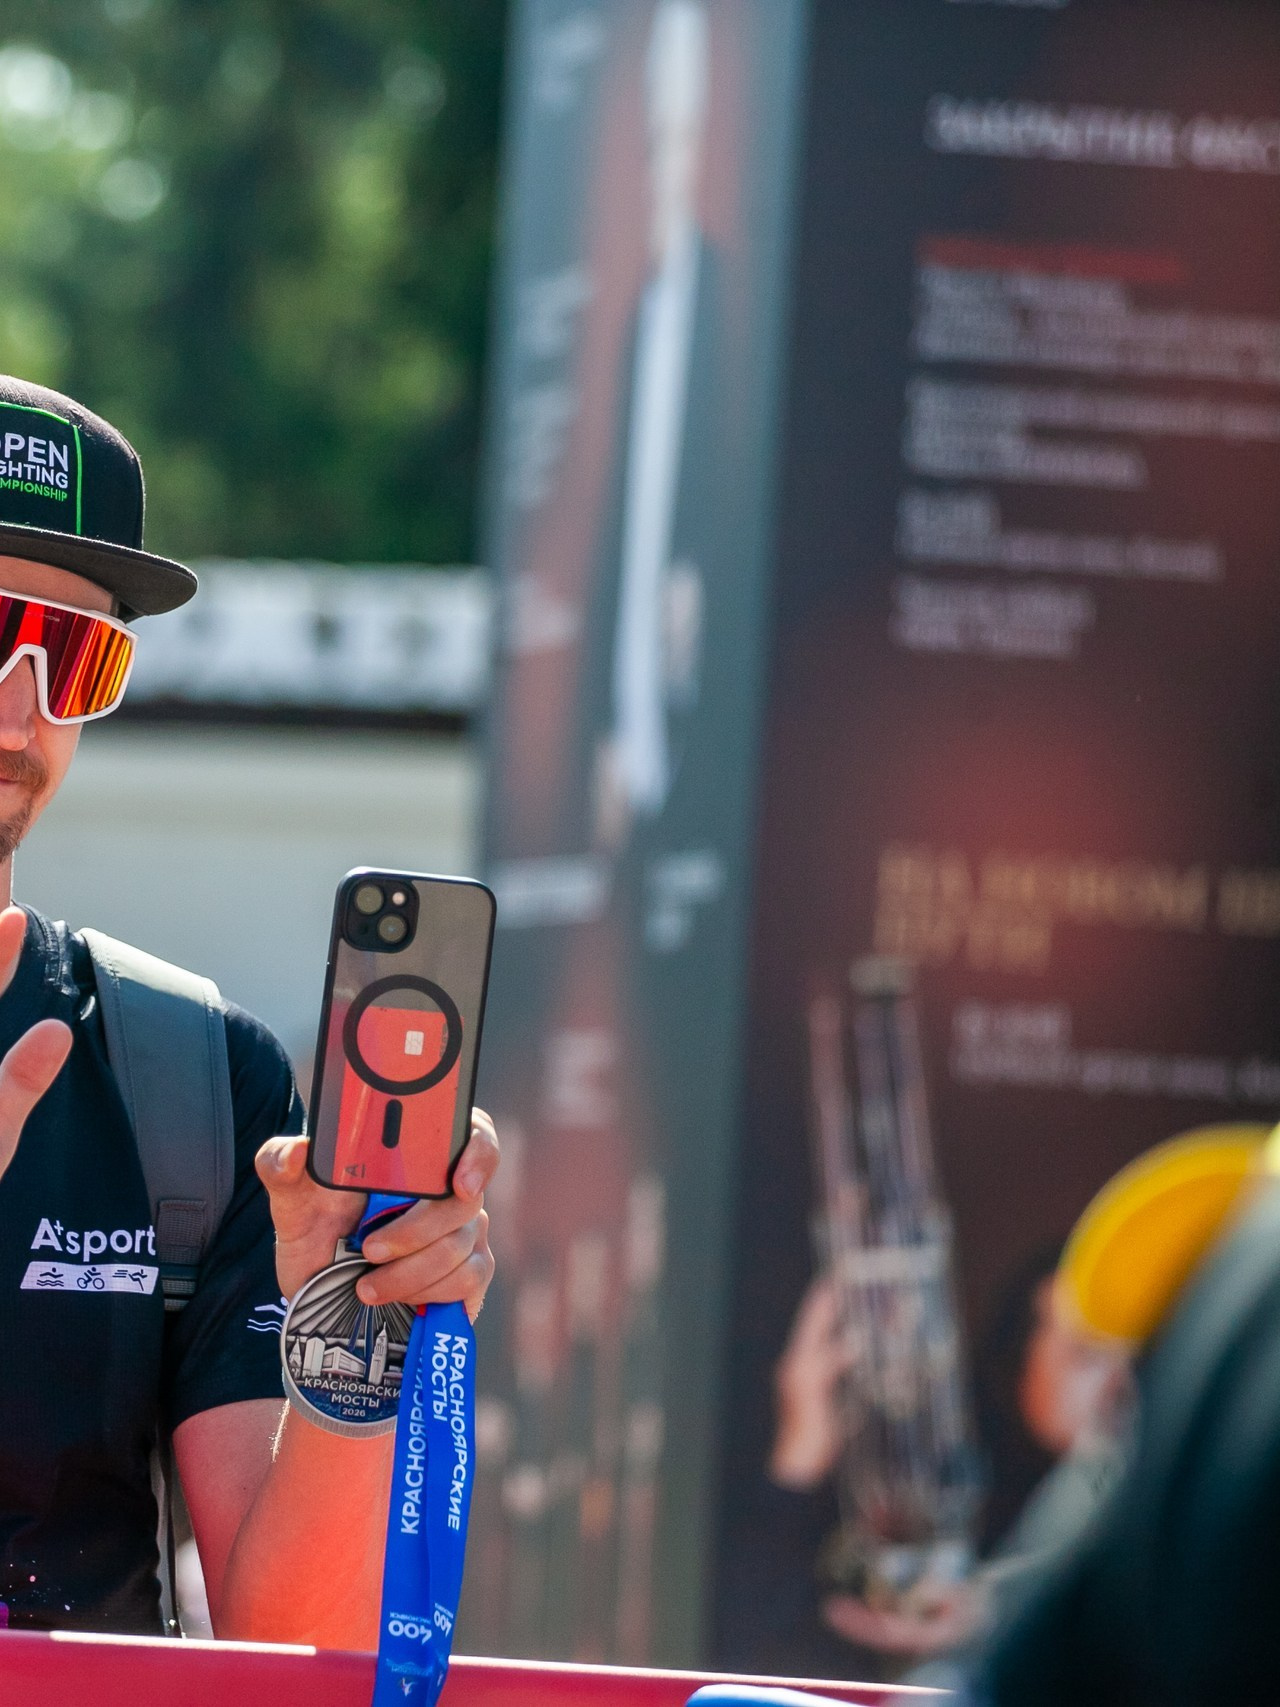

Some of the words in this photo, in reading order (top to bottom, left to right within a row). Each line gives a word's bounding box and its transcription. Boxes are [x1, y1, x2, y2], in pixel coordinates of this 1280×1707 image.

[304, 1377, 402, 1399] КРАСНОЯРСКИ
[431, 1331, 452, 1422] МОСТЫ
[331, 1393, 380, 1409] МОСТЫ
[342, 1407, 366, 1417] 2026
[447, 1335, 469, 1532] КРАСНОЯРСКИЕ
[388, 1619, 432, 1645] 400
[434, 1609, 452, 1638] 400
